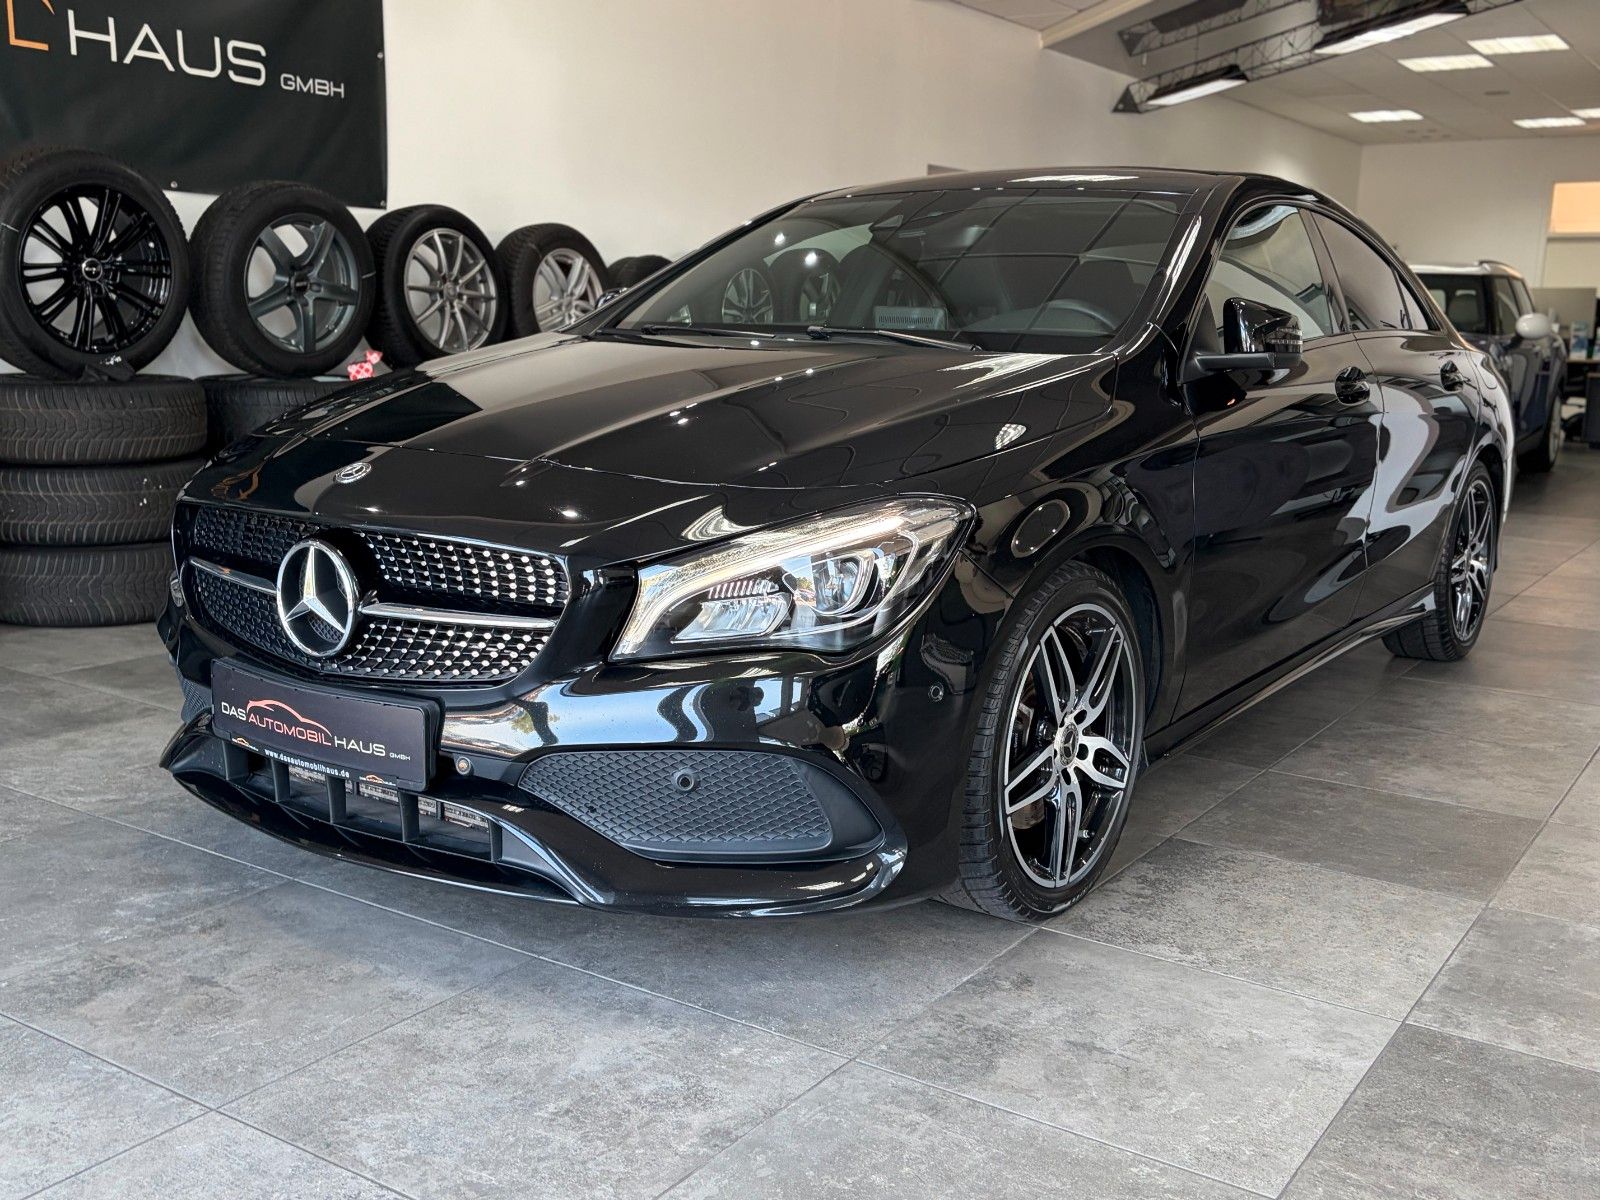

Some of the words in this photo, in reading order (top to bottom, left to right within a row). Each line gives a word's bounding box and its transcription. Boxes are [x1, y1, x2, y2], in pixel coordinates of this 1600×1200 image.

[67, 9, 267, 87] HAUS
[280, 73, 345, 99] GMBH
[221, 702, 247, 721] DAS
[248, 713, 332, 746] AUTOMOBIL
[334, 735, 386, 757] HAUS
[389, 752, 411, 761] GMBH
[264, 748, 350, 778] www.dasautomobilhaus.de
